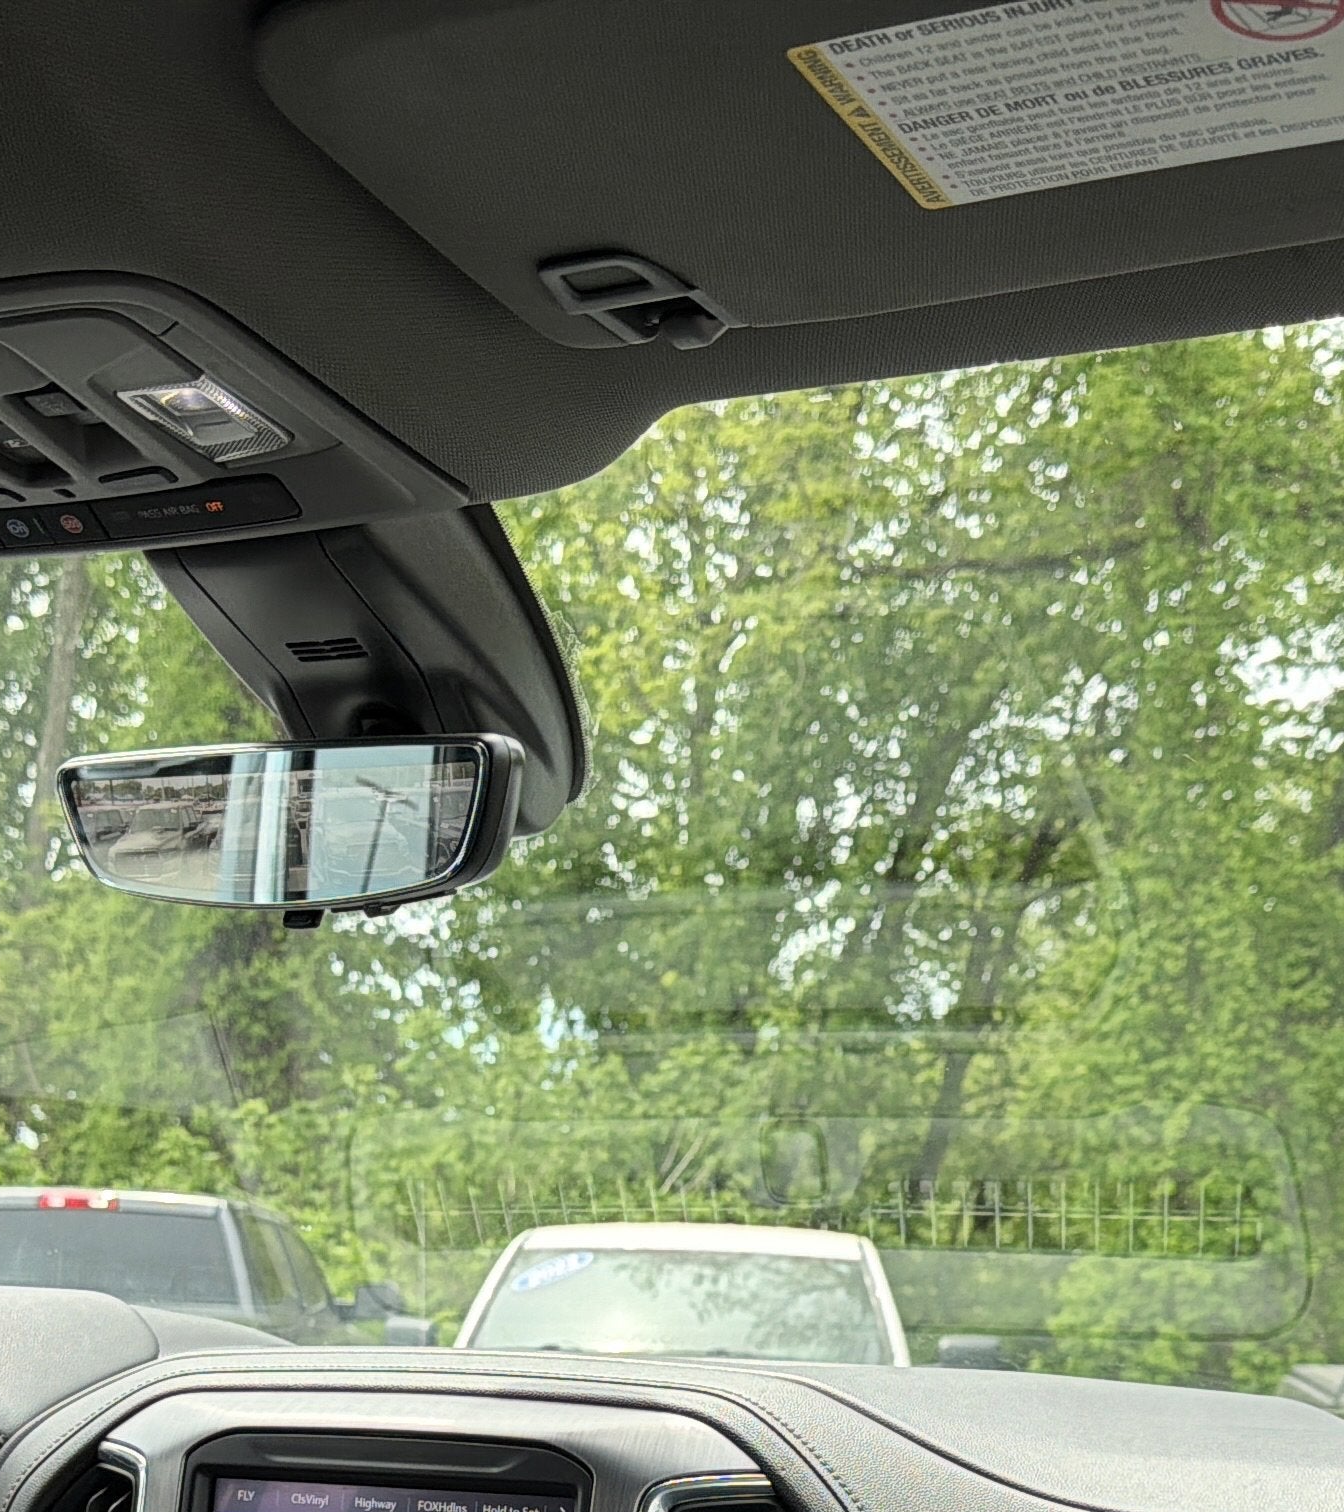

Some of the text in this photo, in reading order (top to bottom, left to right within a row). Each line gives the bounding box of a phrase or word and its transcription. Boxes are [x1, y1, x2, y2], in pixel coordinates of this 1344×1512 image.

[828, 34, 893, 54] DEATH
[917, 12, 1002, 36] SERIOUS
[895, 60, 932, 73] BACK
[898, 111, 974, 132] DANGER
[976, 106, 1003, 118] DE
[1005, 95, 1060, 112] MORT
[1120, 63, 1234, 92] BLESSURES
[1237, 46, 1324, 70] GRAVES.
[797, 49, 945, 203] AVERTISSEMENT WARNING
[206, 501, 223, 512] OFF
[237, 1489, 255, 1501] FLY
[291, 1493, 329, 1508] ClsVinyl
[354, 1497, 397, 1512] Highway
